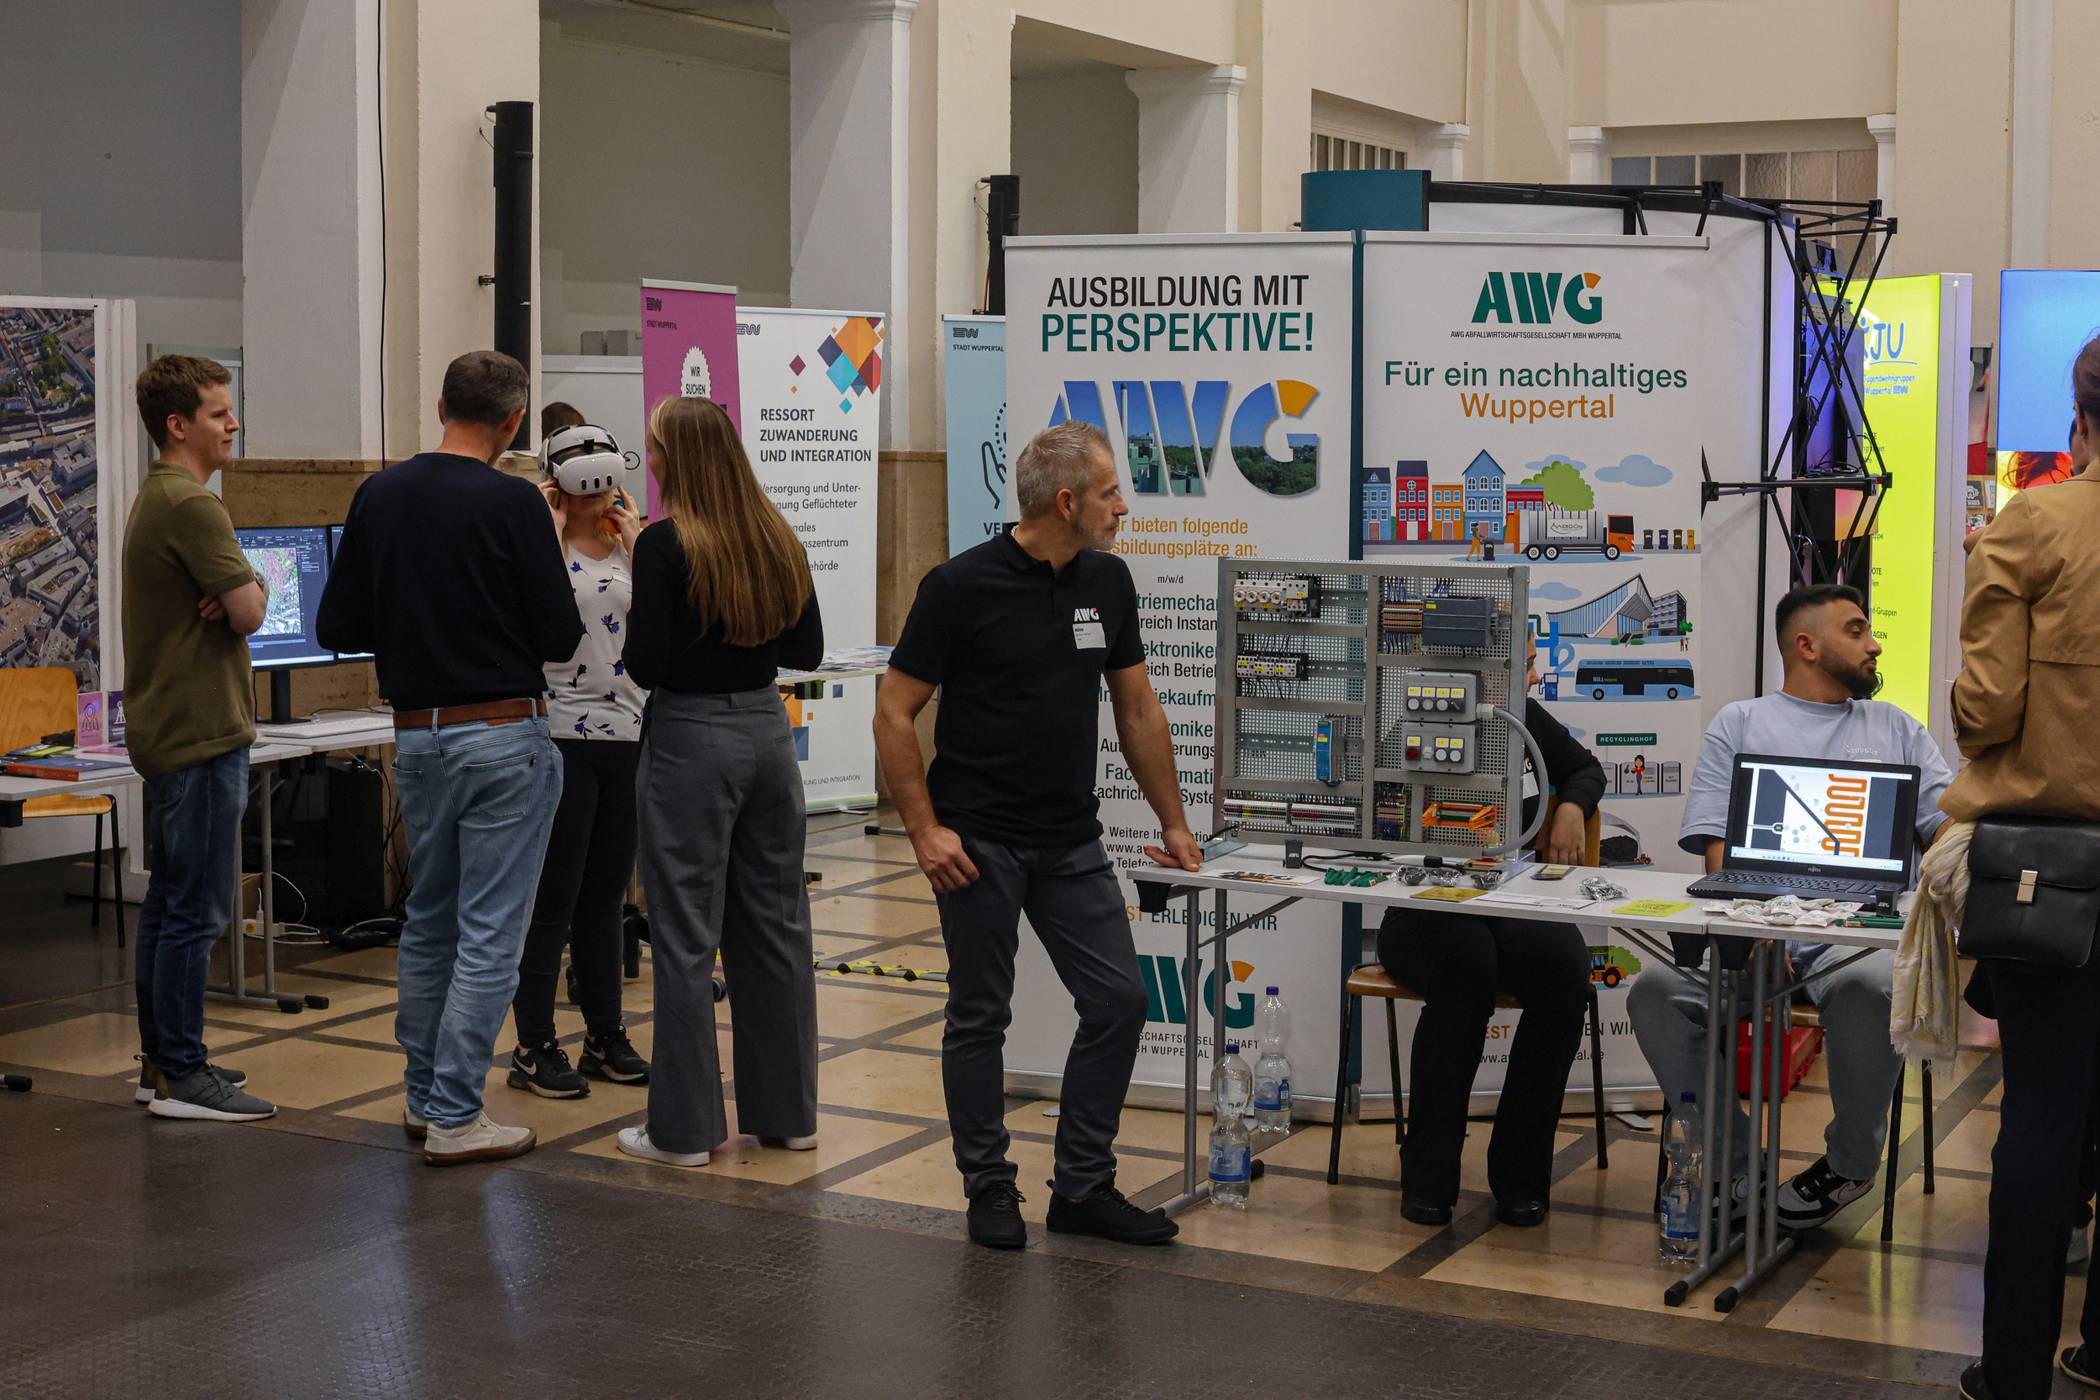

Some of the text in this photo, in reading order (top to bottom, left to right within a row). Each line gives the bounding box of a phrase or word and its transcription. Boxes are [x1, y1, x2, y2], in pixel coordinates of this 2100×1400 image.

[1047, 274, 1309, 307] AUSBILDUNG MIT
[1471, 271, 1602, 324] AWG
[1042, 312, 1313, 353] PERSPEKTIVE!
[1465, 331, 1572, 340] ABFALLWIRTSCHAFTSGESELLSCHAFT
[1573, 331, 1587, 340] MBH
[1588, 332, 1622, 340] WUPPERTAL
[971, 344, 1004, 352] WUPPERTAL
[690, 366, 701, 377] WIR
[1385, 360, 1688, 393] Für ein nachhaltiges
[685, 383, 706, 395] SUCHEN
[760, 408, 815, 421] RESSORT
[1460, 393, 1615, 424] Wuppertal
[759, 429, 859, 442] ZUWANDERUNG
[760, 449, 872, 462] UND INTEGRATION
[813, 482, 829, 493] und
[832, 482, 861, 493] Unter-
[777, 498, 858, 512] gung Geflüchteter
[793, 522, 816, 532] nales
[1132, 516, 1177, 533] bieten
[1183, 517, 1249, 537] folgende
[801, 538, 849, 548] nszentrum
[1106, 538, 1258, 559] sbildungsplätze an:
[809, 560, 839, 571] ehörde
[1871, 567, 1882, 576] OTE
[1157, 575, 1184, 584] m/w/d
[1136, 592, 1218, 611] triemecha
[1074, 607, 1101, 622] AWG
[1140, 615, 1217, 631] reich Instan
[1873, 630, 1888, 640] AGEN
[1142, 640, 1216, 658] ektronike
[1146, 662, 1169, 676] eich
[1181, 788, 1214, 806] Syste
[1109, 826, 1150, 839] Weitere
[1125, 905, 1143, 922] ST
[1246, 913, 1278, 931] WIR
[1136, 954, 1256, 1029] WG
[1151, 1045, 1210, 1059] WUPPEAL
